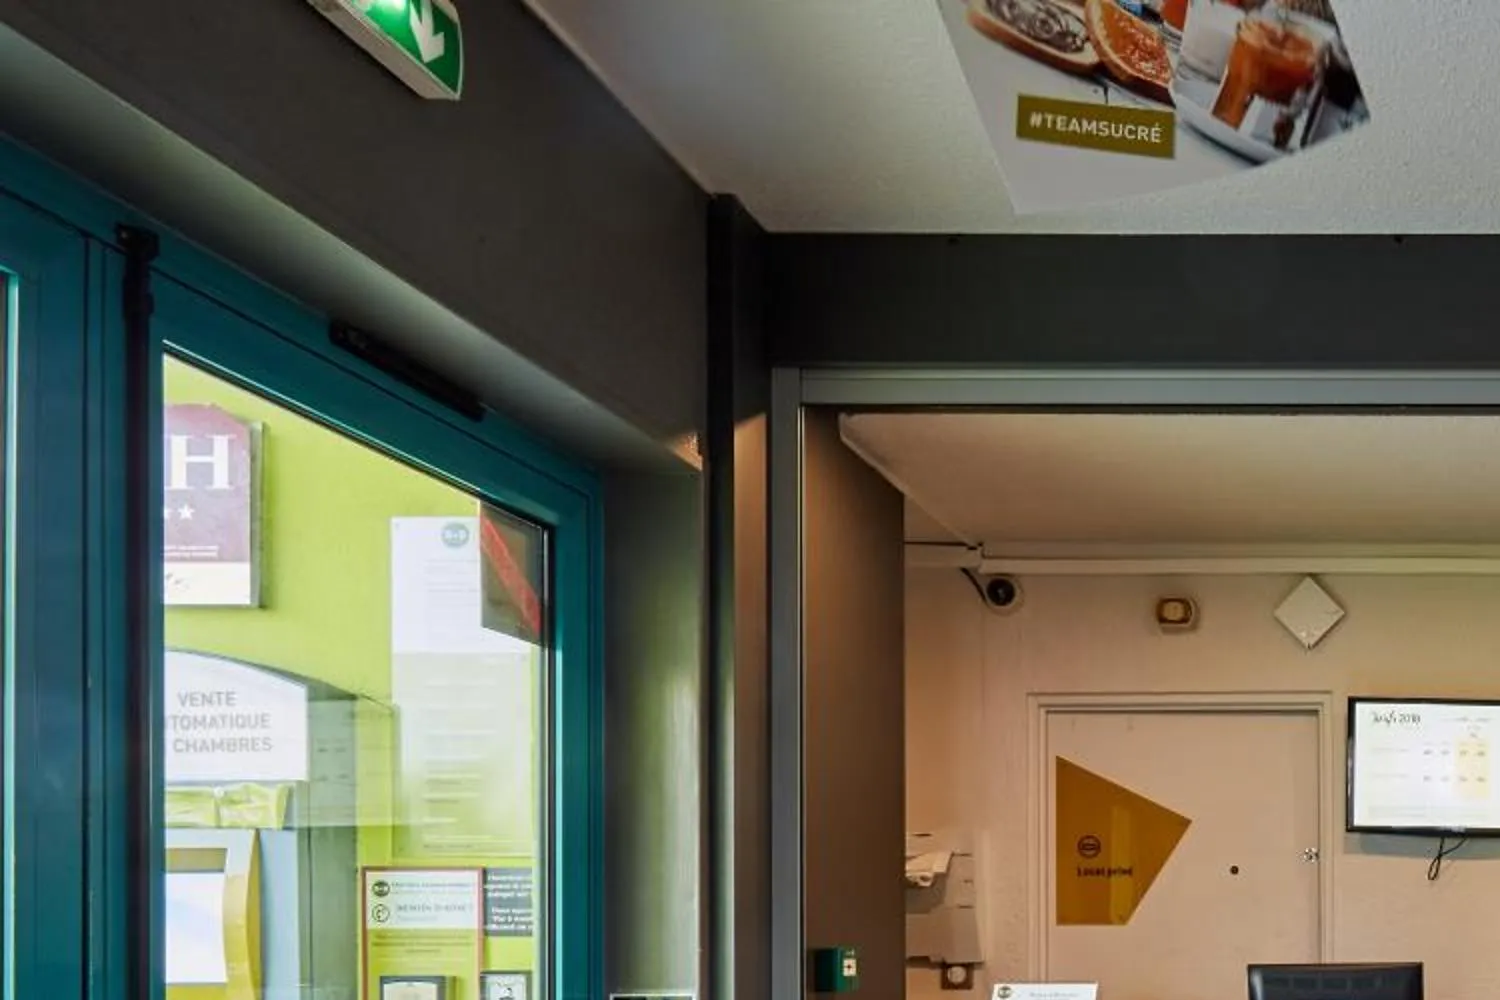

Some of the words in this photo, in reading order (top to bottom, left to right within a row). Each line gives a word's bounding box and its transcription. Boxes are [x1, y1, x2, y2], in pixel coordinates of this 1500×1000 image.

[1029, 111, 1163, 143] #TEAMSUCRÉ
[177, 690, 237, 707] VENTE
[166, 713, 272, 731] TOMATIQUE
[172, 737, 273, 753] CHAMBRES
